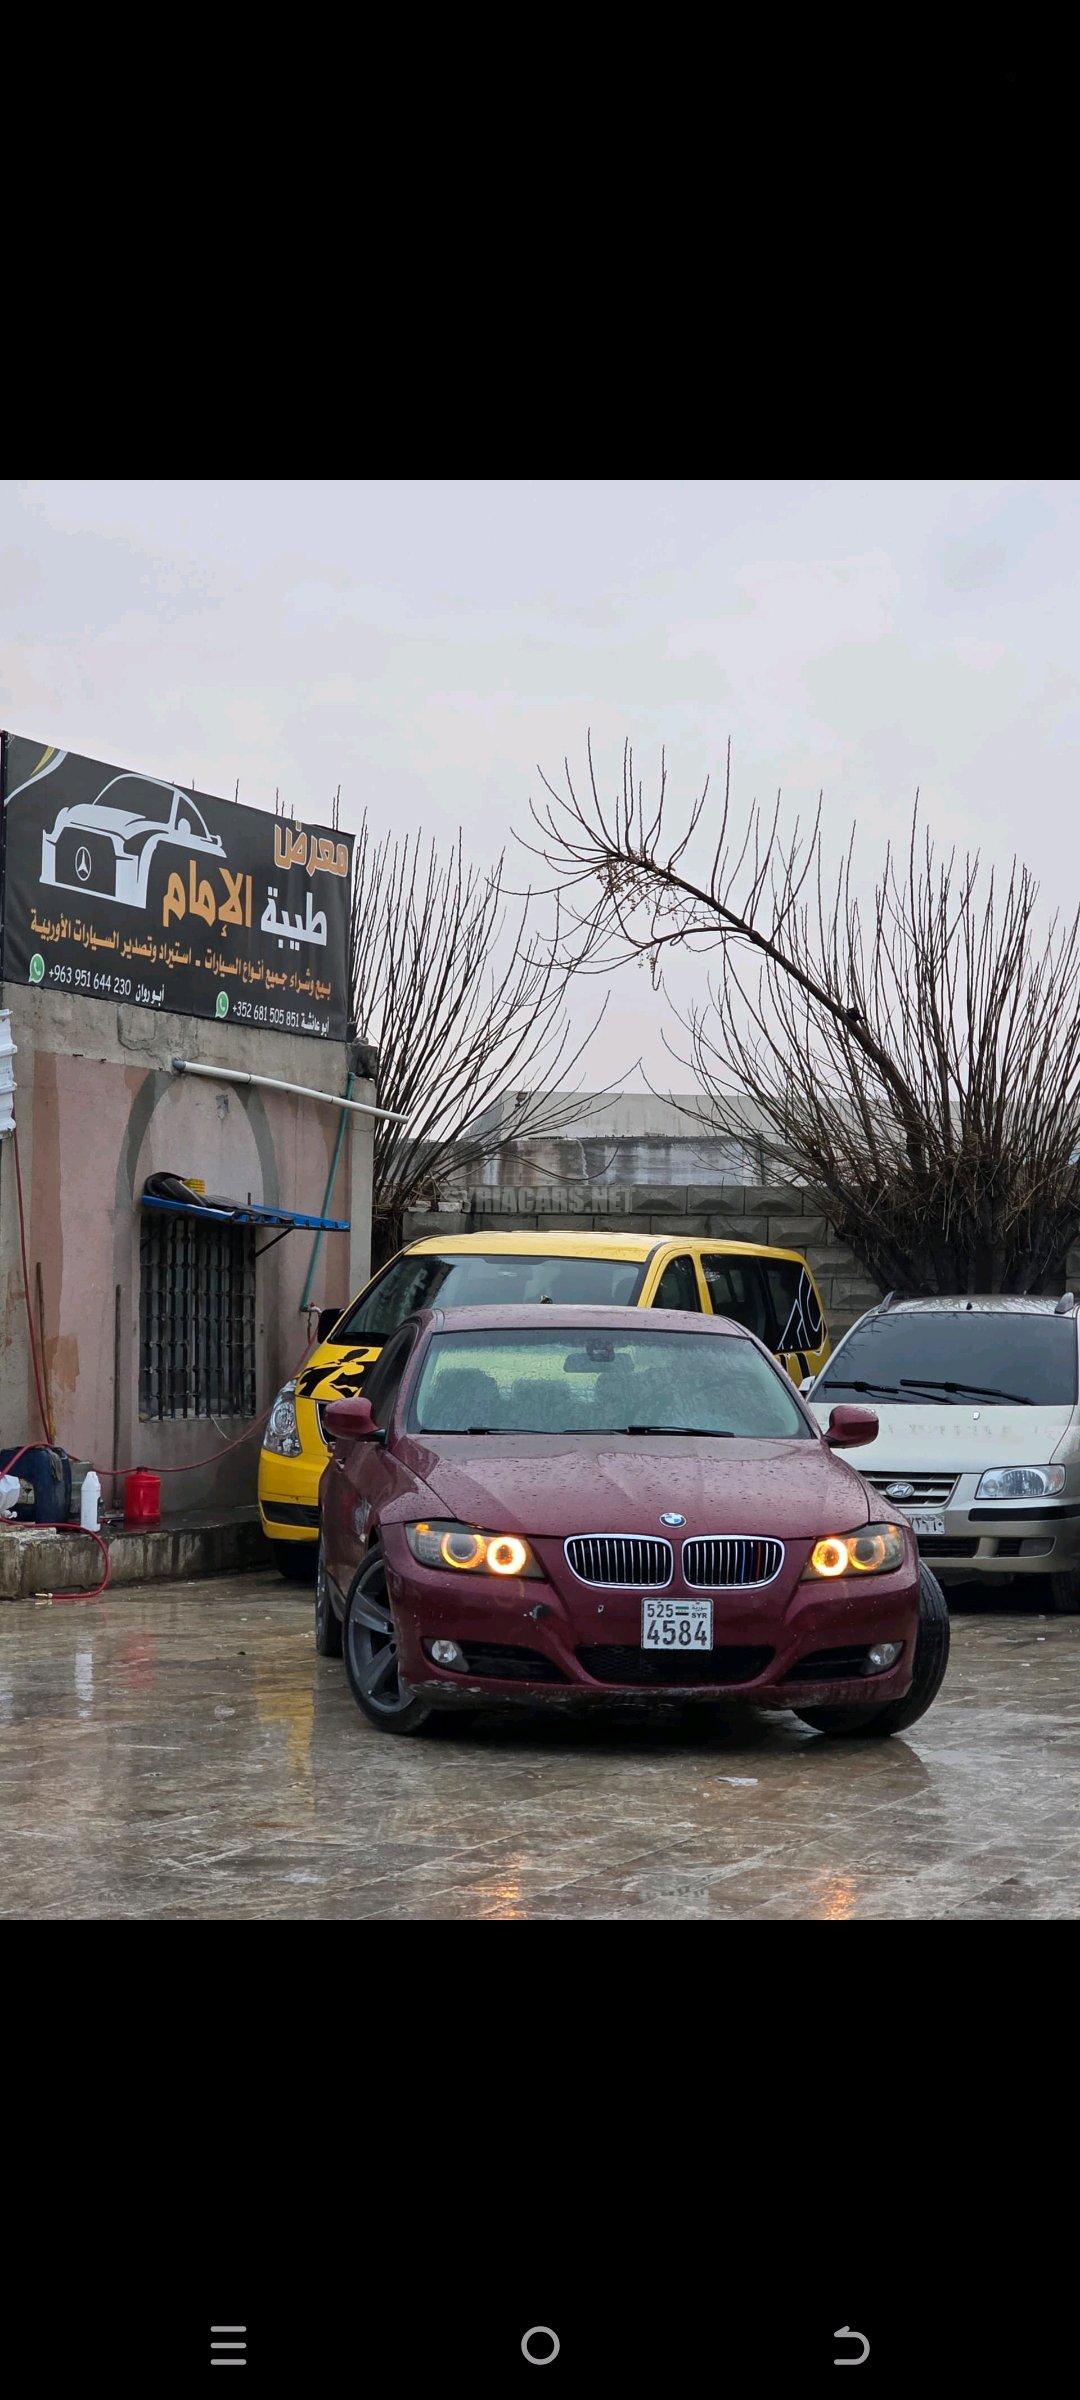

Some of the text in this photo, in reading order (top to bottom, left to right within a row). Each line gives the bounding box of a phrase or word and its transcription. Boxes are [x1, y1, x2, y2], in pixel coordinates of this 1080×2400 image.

[274, 820, 349, 877] معرض
[163, 859, 327, 951] طيبة الإمام
[31, 908, 71, 942] الأوربية
[75, 918, 119, 951] السيارات
[120, 935, 157, 964] وتصدير
[159, 941, 192, 969] استيراد
[204, 948, 241, 978] السيارات
[49, 964, 72, 984] +963
[75, 968, 91, 988] 951
[93, 972, 111, 992] 644
[113, 977, 132, 996] 230
[265, 969, 288, 991] جميع
[290, 967, 314, 996] وشراء
[314, 980, 331, 1000] بيع
[232, 1001, 252, 1018] +352
[253, 1004, 267, 1023] 681
[269, 1007, 284, 1025] 505
[286, 1011, 299, 1028] 851
[647, 1603, 674, 1618] 525
[646, 1620, 708, 1646] 4584
